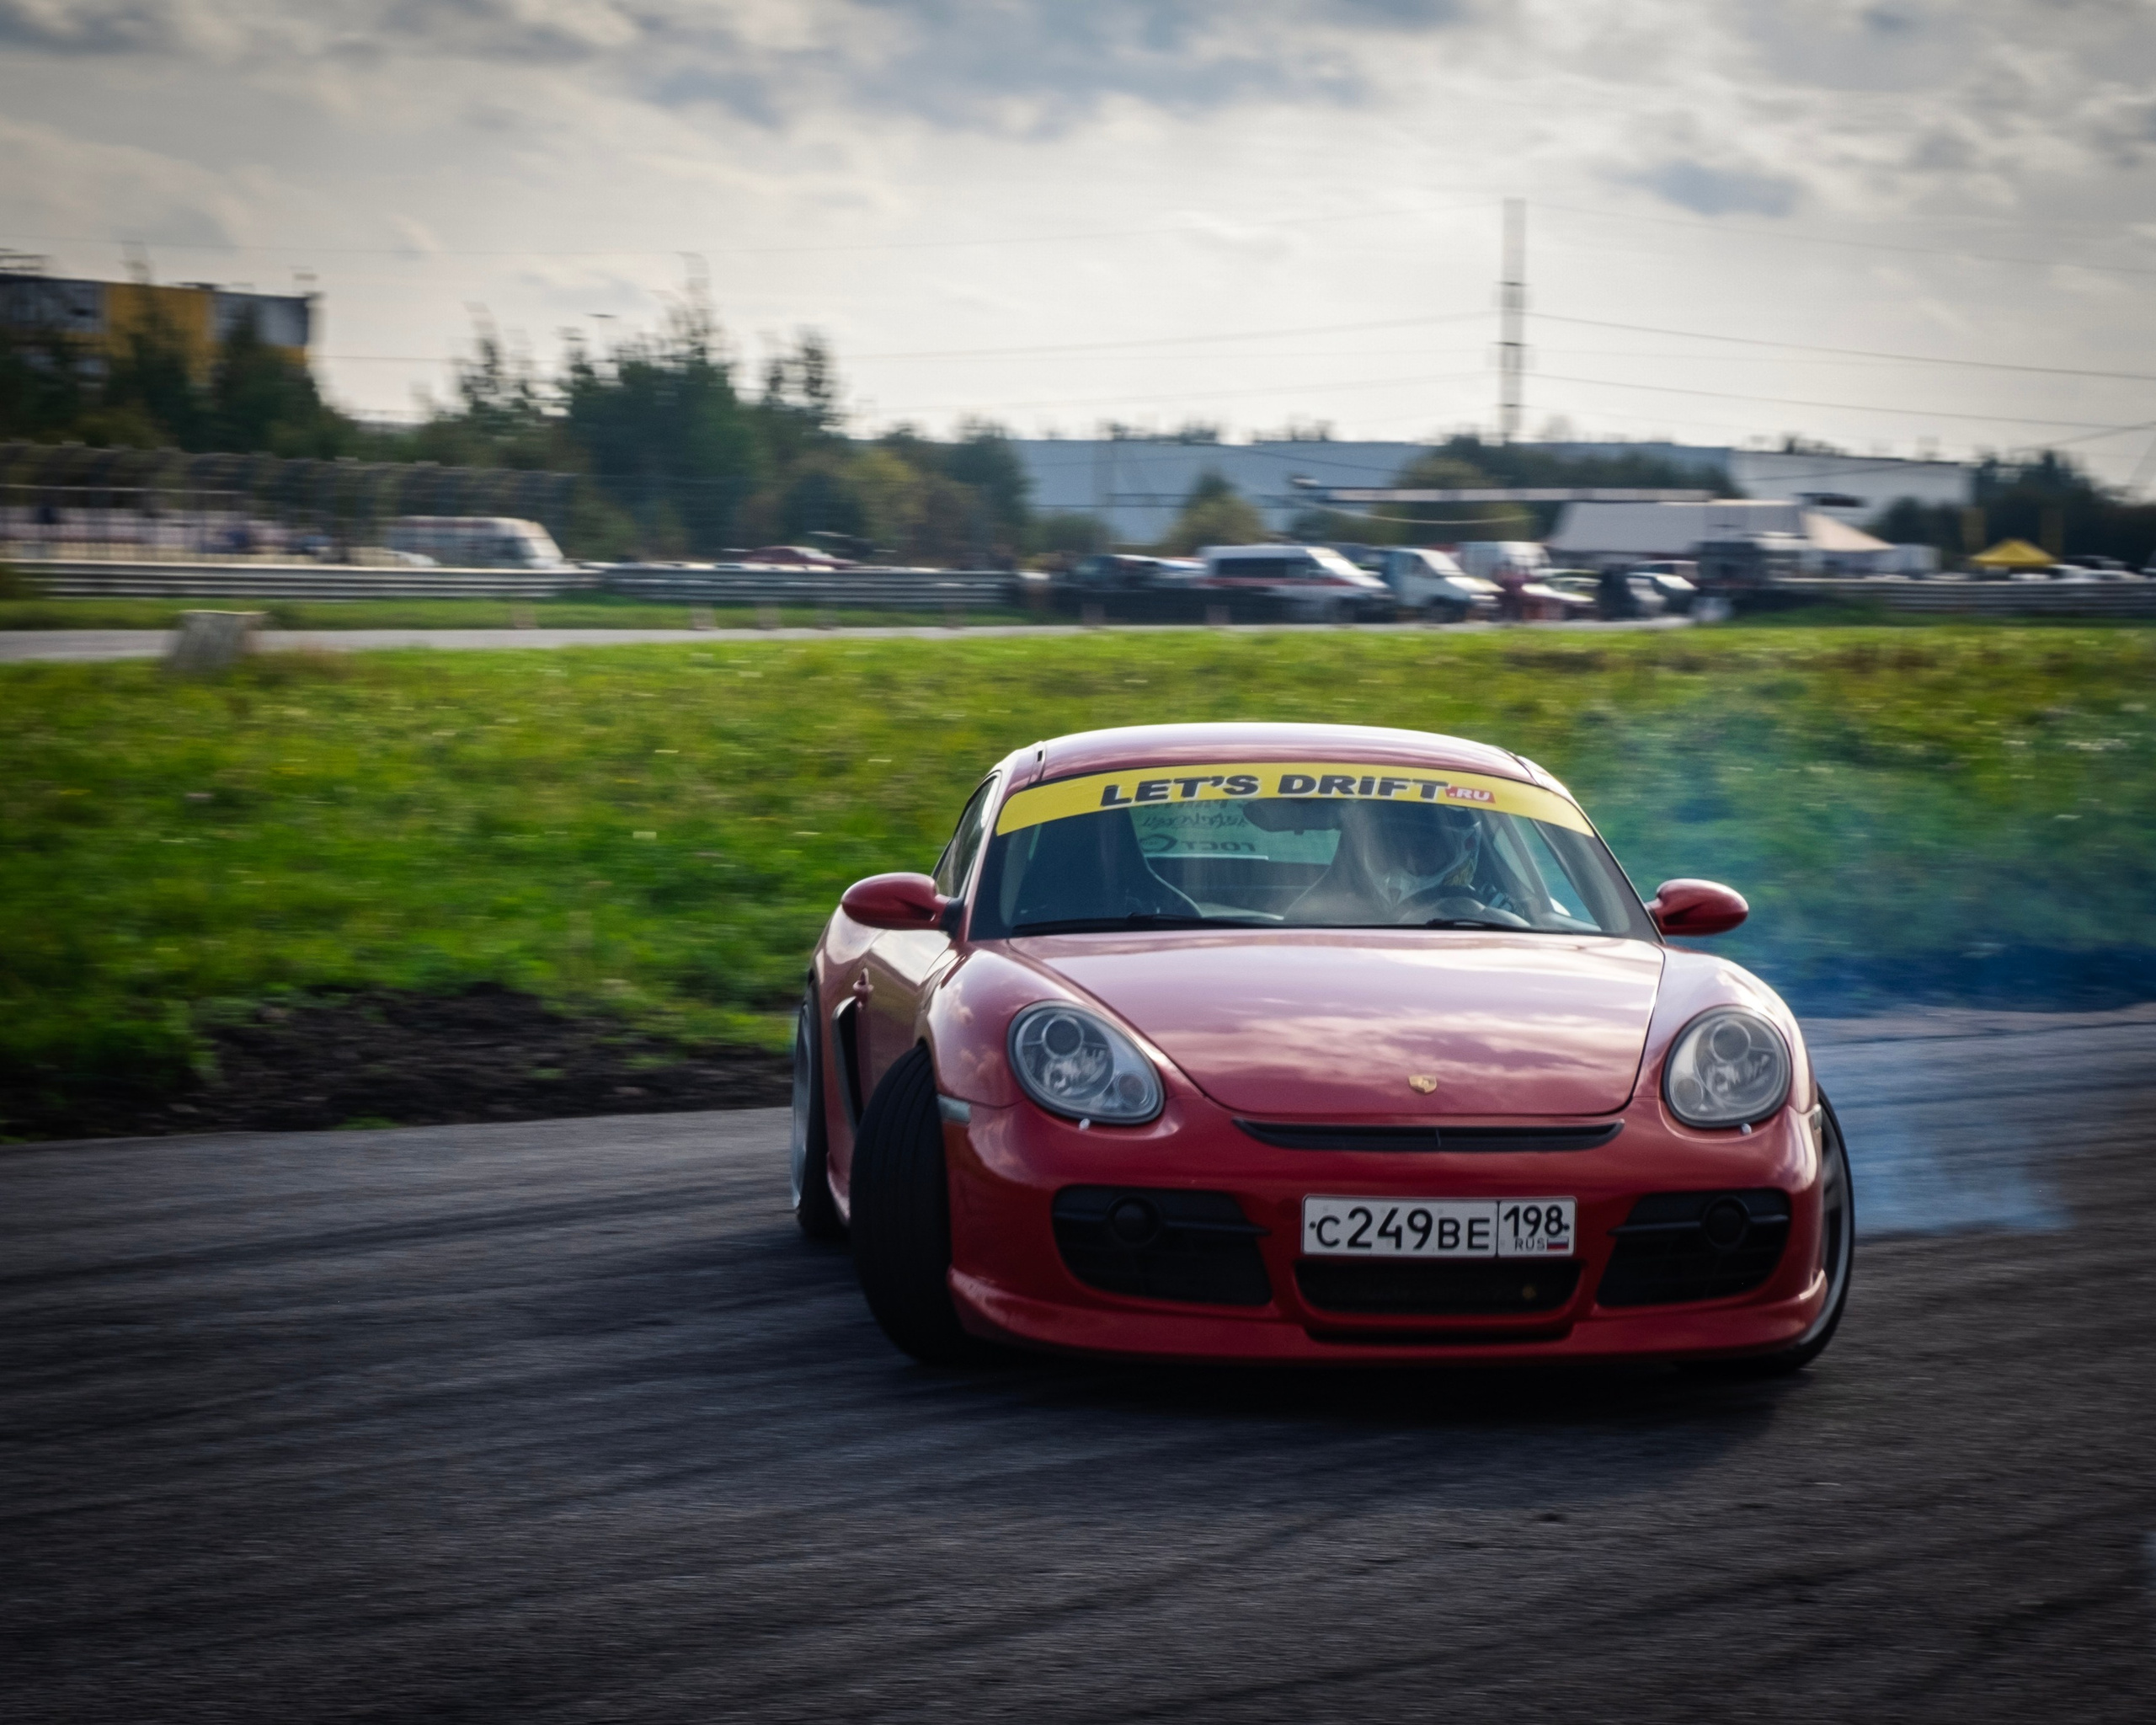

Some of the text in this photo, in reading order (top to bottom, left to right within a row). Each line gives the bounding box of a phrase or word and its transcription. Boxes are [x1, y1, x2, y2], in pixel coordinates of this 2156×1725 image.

[1100, 775, 1259, 806] LET'S
[1503, 1204, 1564, 1237] 198
[1516, 1237, 1545, 1251] RUS
